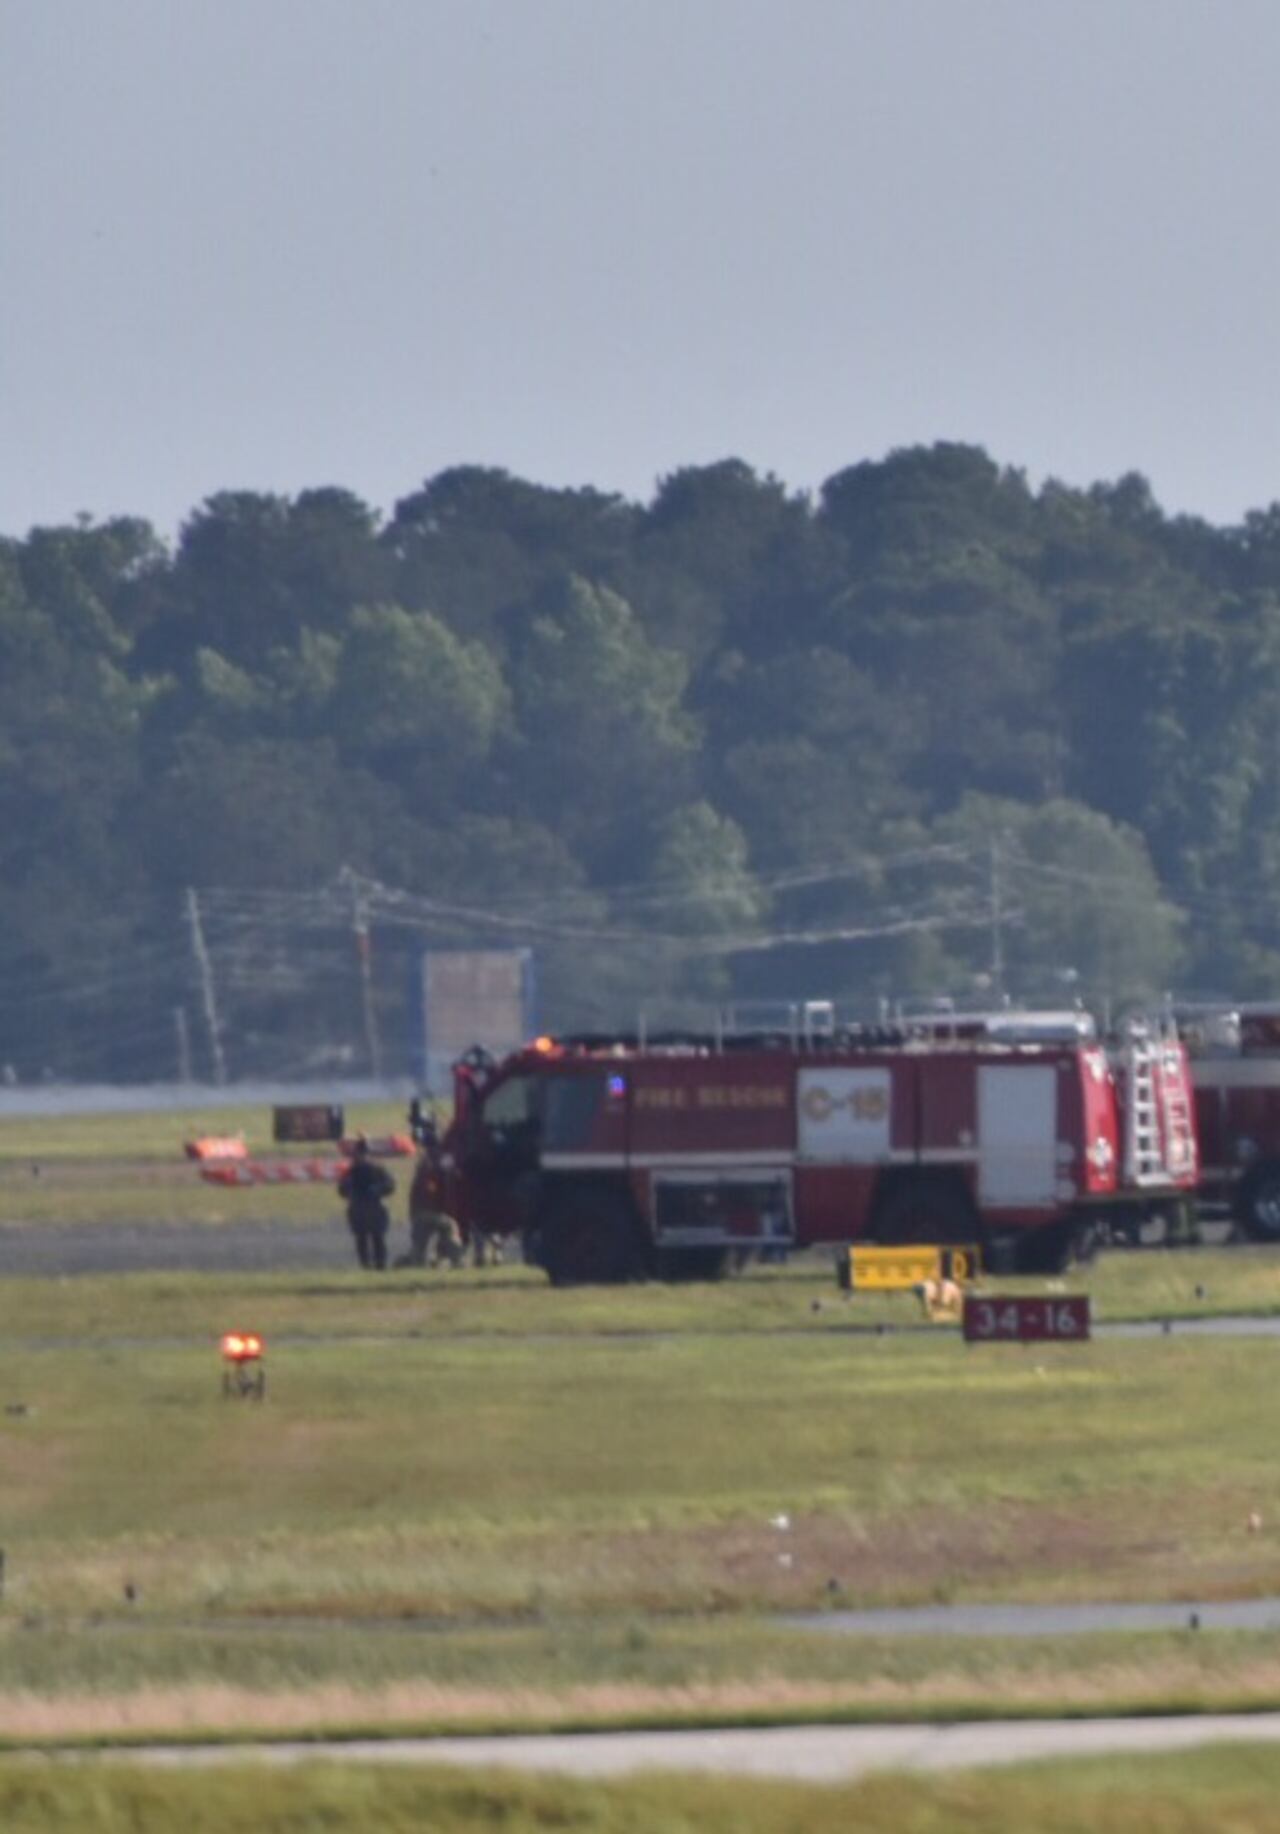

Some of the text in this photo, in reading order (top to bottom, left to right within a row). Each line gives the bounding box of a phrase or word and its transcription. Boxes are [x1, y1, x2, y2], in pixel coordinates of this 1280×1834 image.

[633, 1085, 787, 1110] FIRE RESCUE
[976, 1303, 1077, 1335] 34-16
